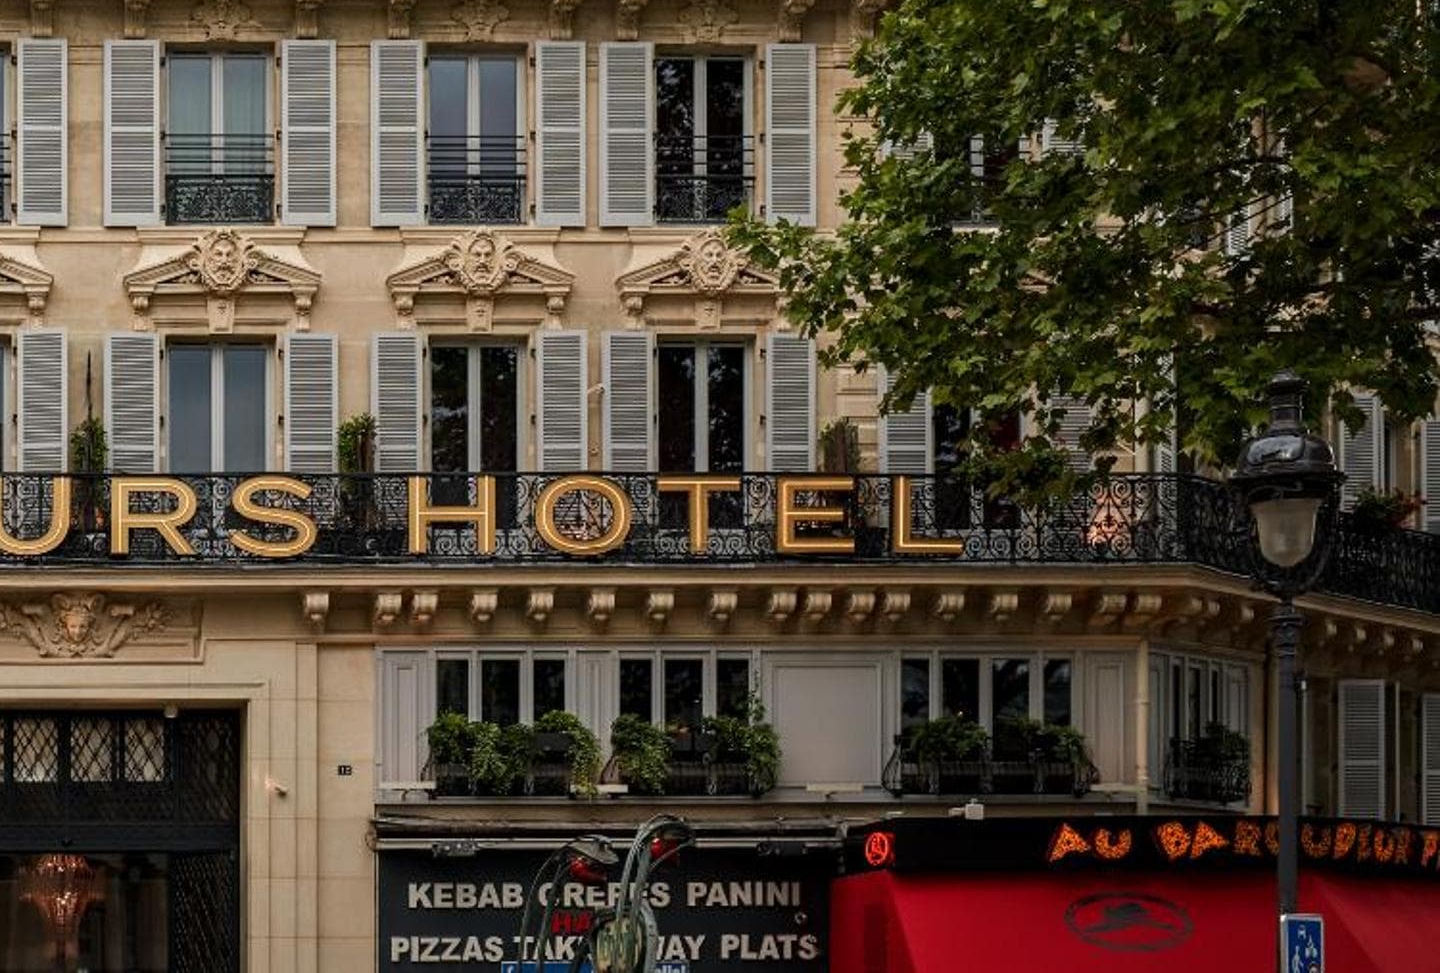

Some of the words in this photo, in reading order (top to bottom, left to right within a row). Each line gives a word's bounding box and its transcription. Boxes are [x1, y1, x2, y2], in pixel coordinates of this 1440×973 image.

[408, 474, 964, 556] HOTEL
[1048, 823, 1132, 862] AU
[408, 882, 524, 909] KEBAB
[686, 881, 801, 907] PANINI
[390, 935, 505, 963] PIZZAS
[513, 935, 596, 962] TAK
[720, 933, 819, 961] PLATS
